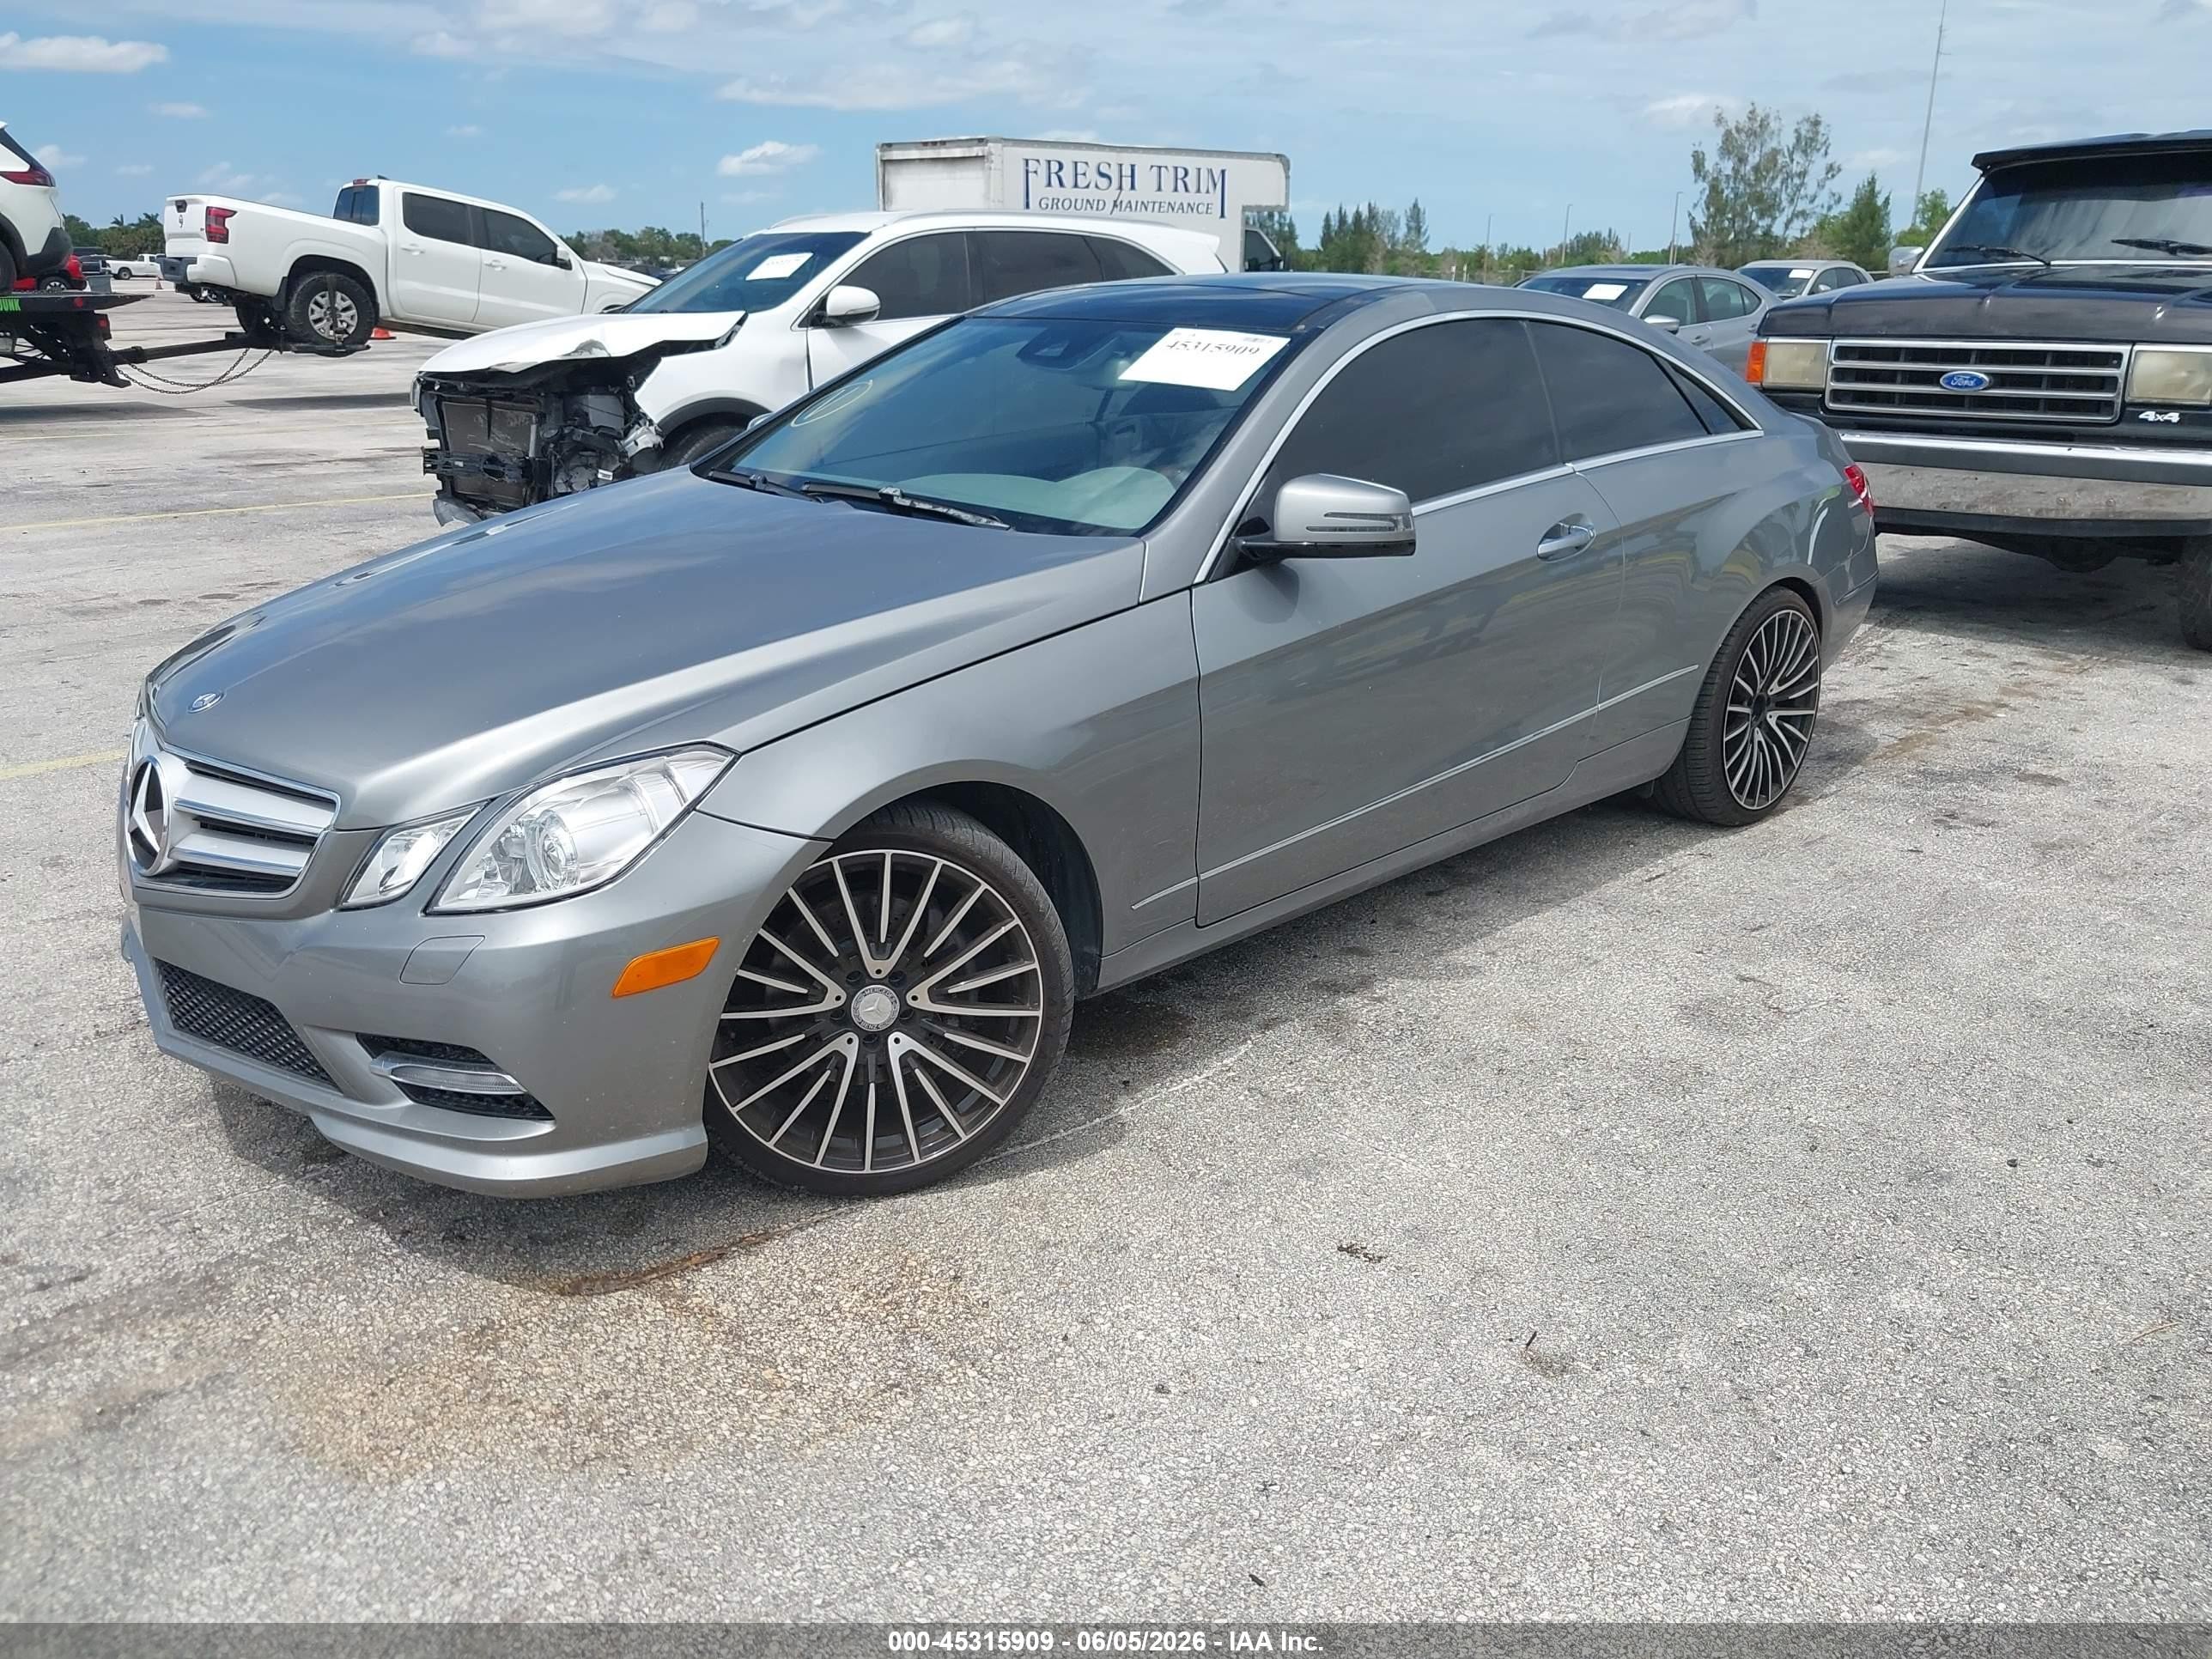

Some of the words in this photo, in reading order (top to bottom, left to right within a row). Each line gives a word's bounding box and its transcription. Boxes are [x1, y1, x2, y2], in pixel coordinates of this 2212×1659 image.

[1023, 158, 1138, 210] FRESH
[1150, 165, 1227, 219] TRIM
[1038, 197, 1107, 212] GROUND
[1109, 192, 1213, 216] MAINTENANCE
[1167, 340, 1261, 356] 45315909
[1951, 375, 1977, 386] Ford
[2138, 410, 2180, 423] 4x4
